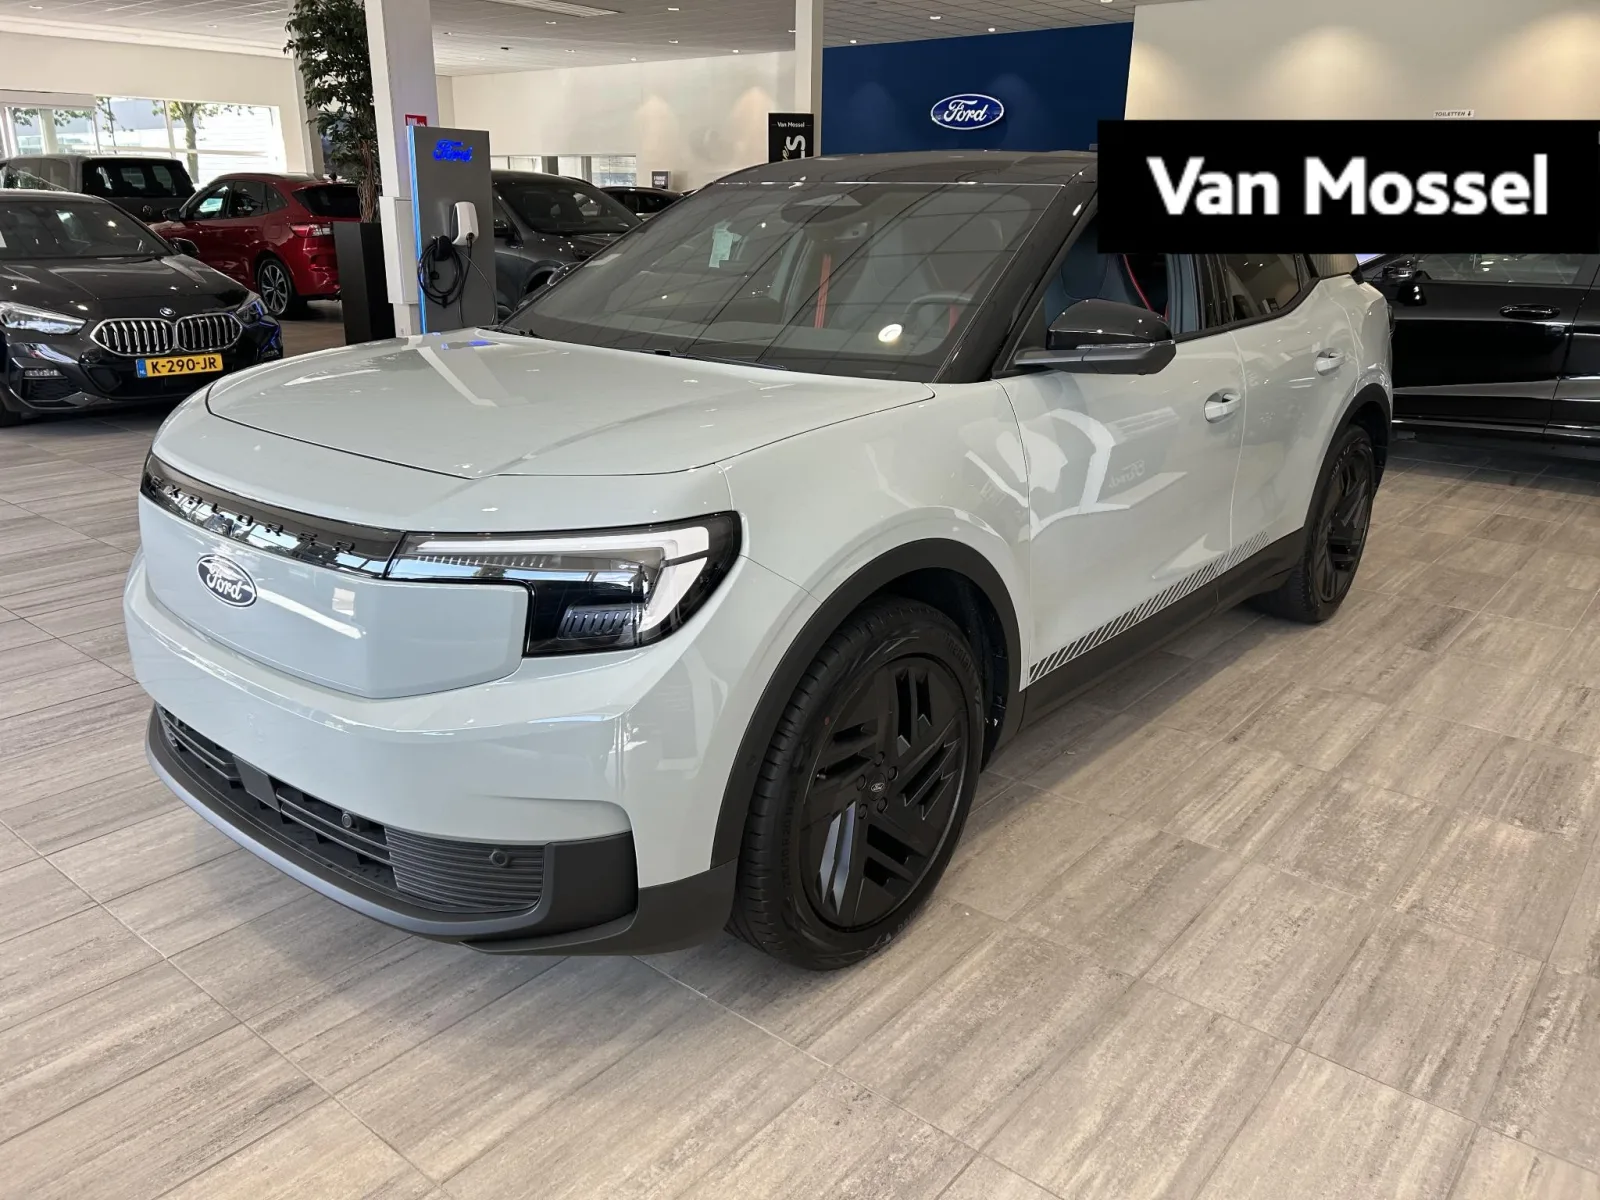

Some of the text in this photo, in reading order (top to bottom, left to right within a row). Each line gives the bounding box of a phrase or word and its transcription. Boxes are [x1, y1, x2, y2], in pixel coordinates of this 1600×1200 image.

[944, 100, 988, 122] Ford
[433, 139, 473, 162] Ford
[151, 357, 217, 374] K-290-JR
[206, 562, 243, 600] Ford
